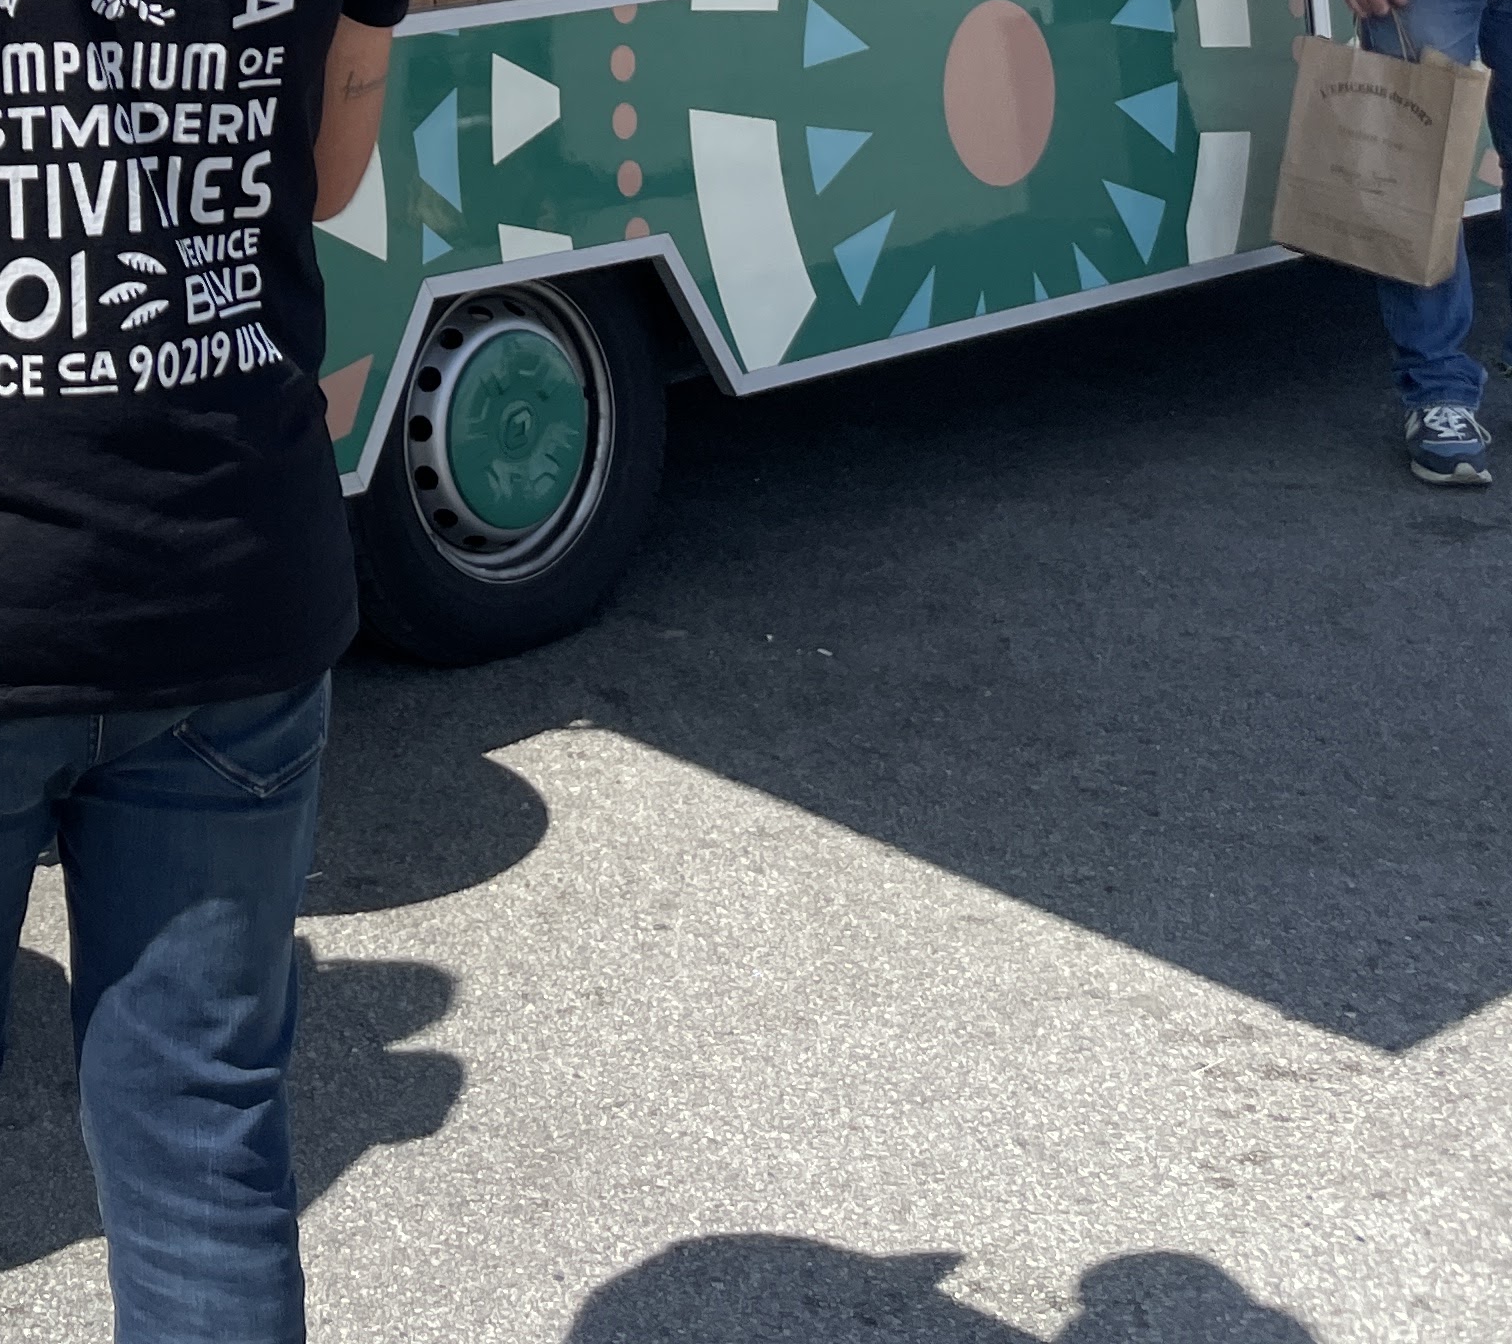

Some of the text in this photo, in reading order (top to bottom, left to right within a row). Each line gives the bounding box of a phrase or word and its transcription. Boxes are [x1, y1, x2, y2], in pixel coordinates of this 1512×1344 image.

[239, 46, 285, 78] OF
[174, 228, 261, 269] VENICE
[185, 263, 262, 326] BLVD
[57, 351, 118, 384] CA
[131, 330, 232, 393] 90219
[235, 321, 283, 372] USA
